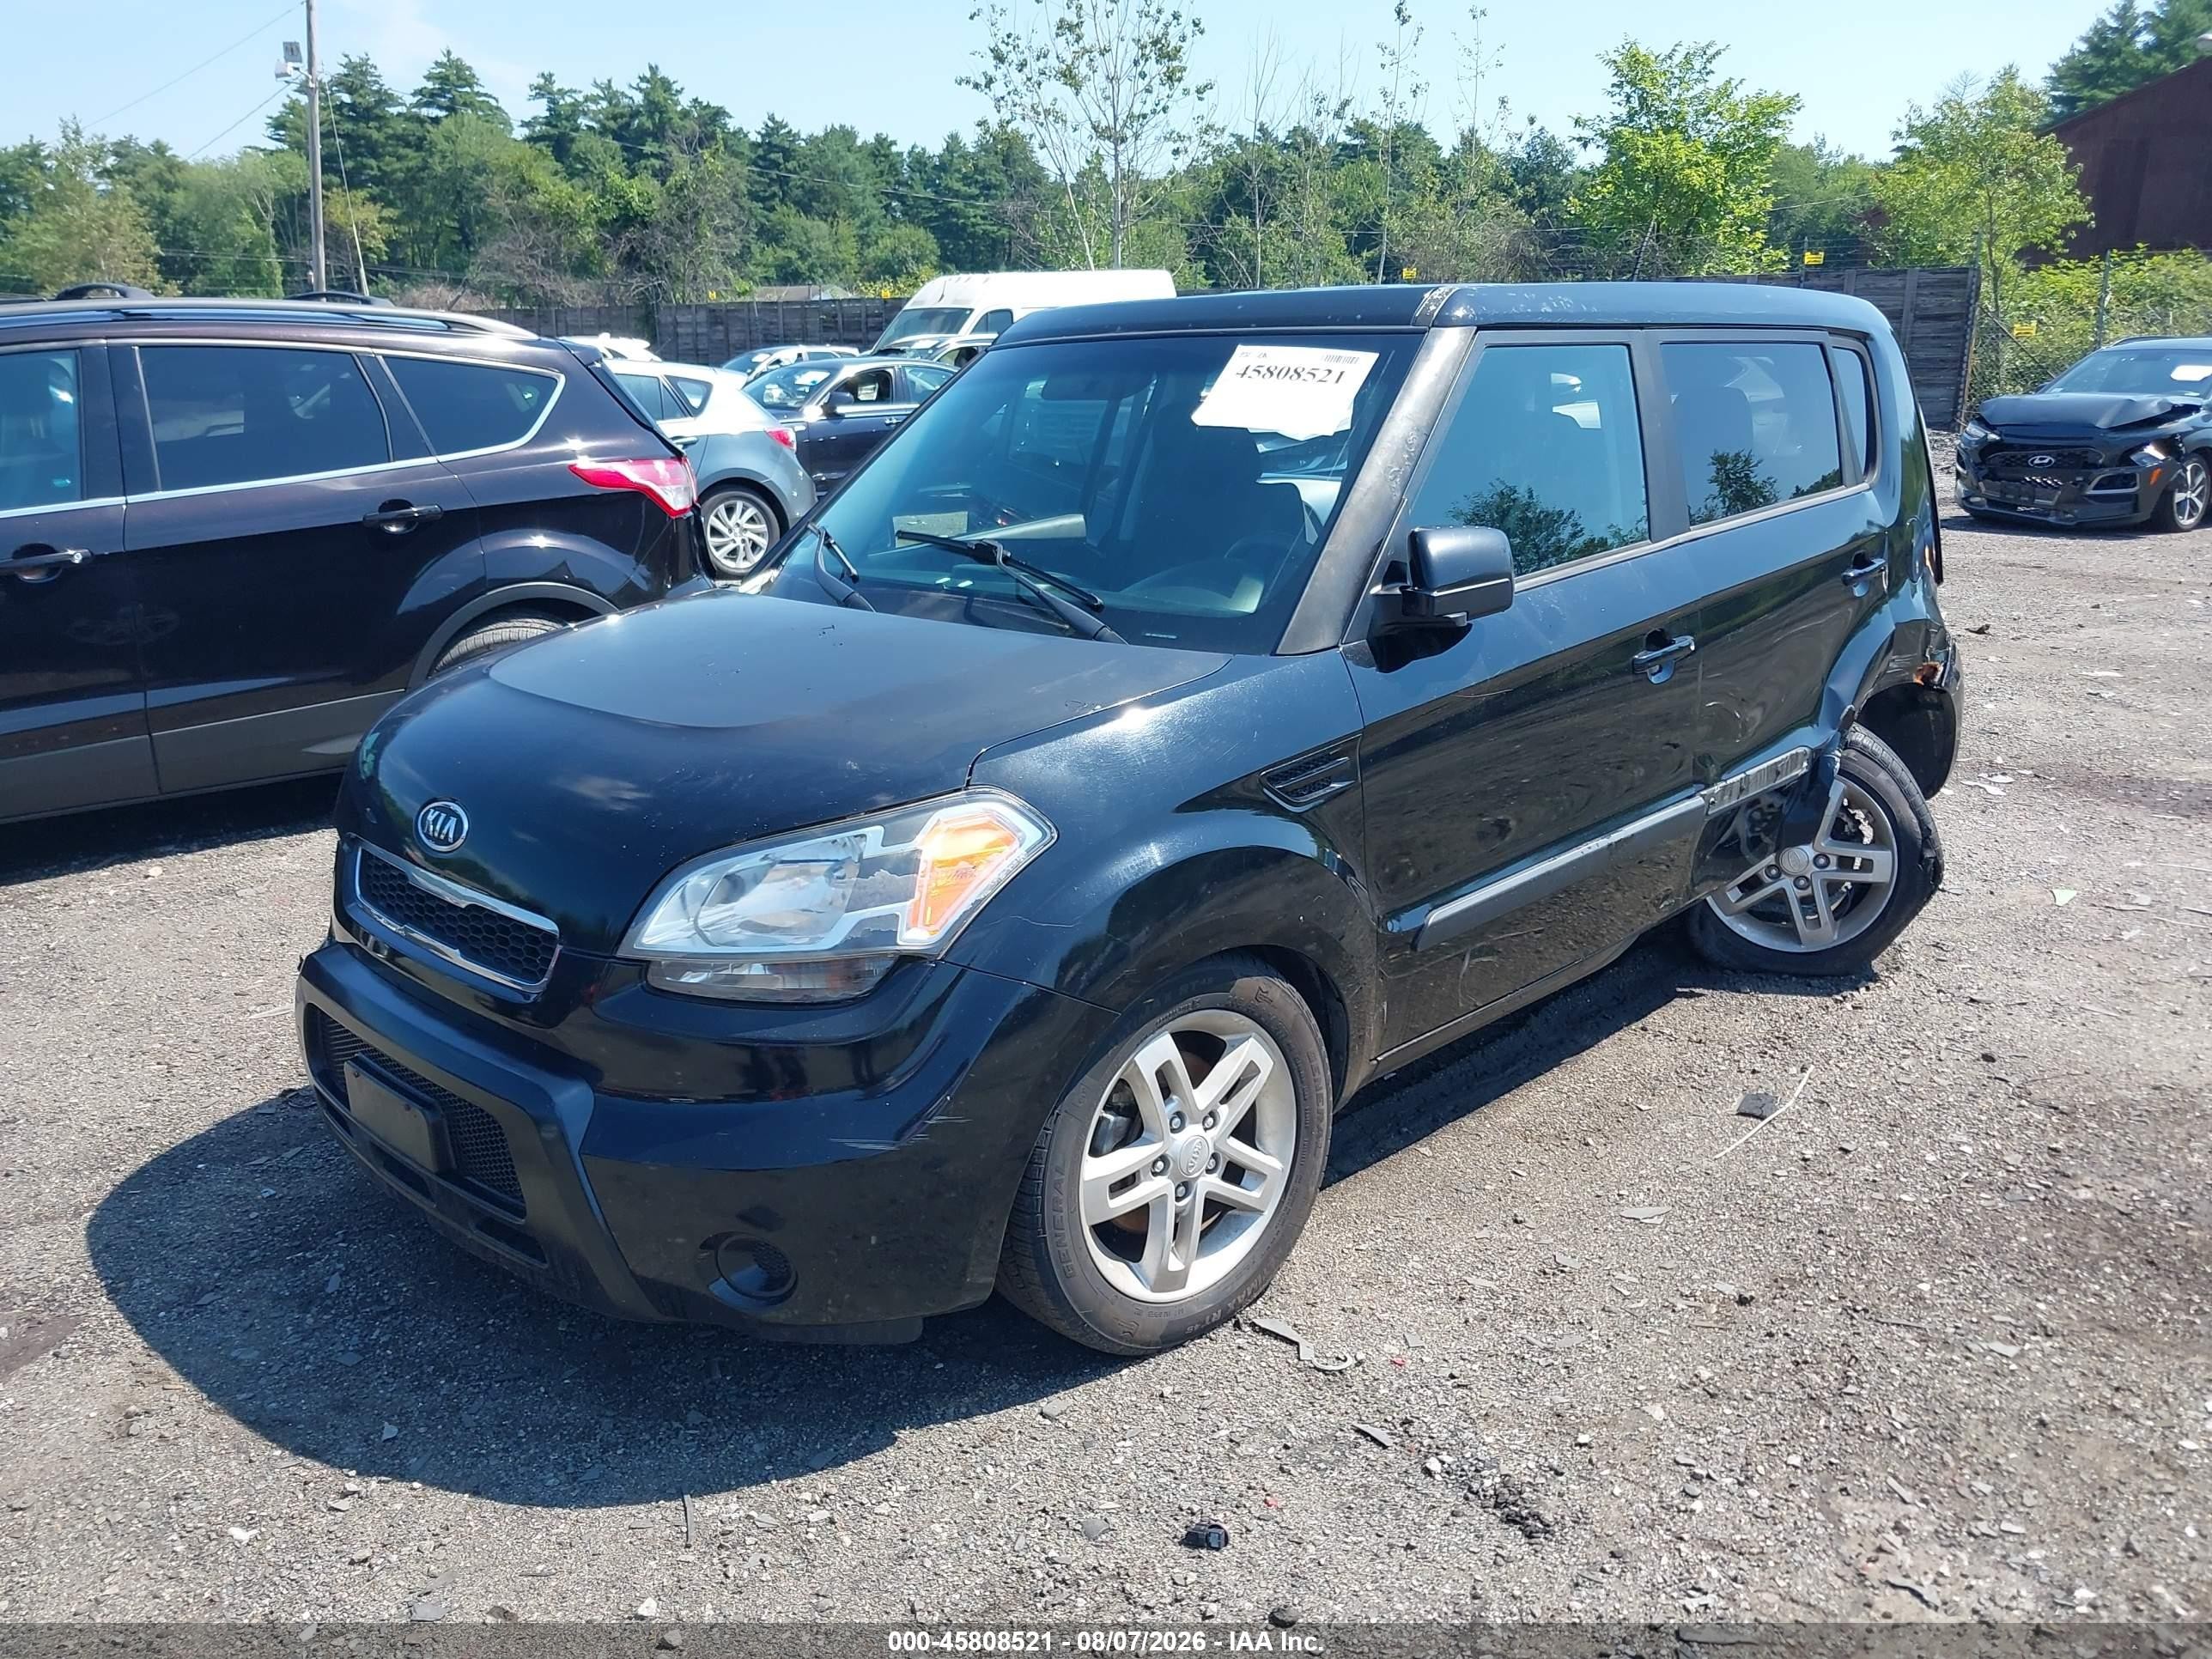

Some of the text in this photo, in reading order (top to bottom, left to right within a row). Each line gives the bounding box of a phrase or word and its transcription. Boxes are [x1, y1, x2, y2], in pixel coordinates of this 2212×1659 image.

[1236, 364, 1346, 385] 45808521
[424, 808, 458, 843] KIA
[1051, 1167, 1076, 1279] GENERAL
